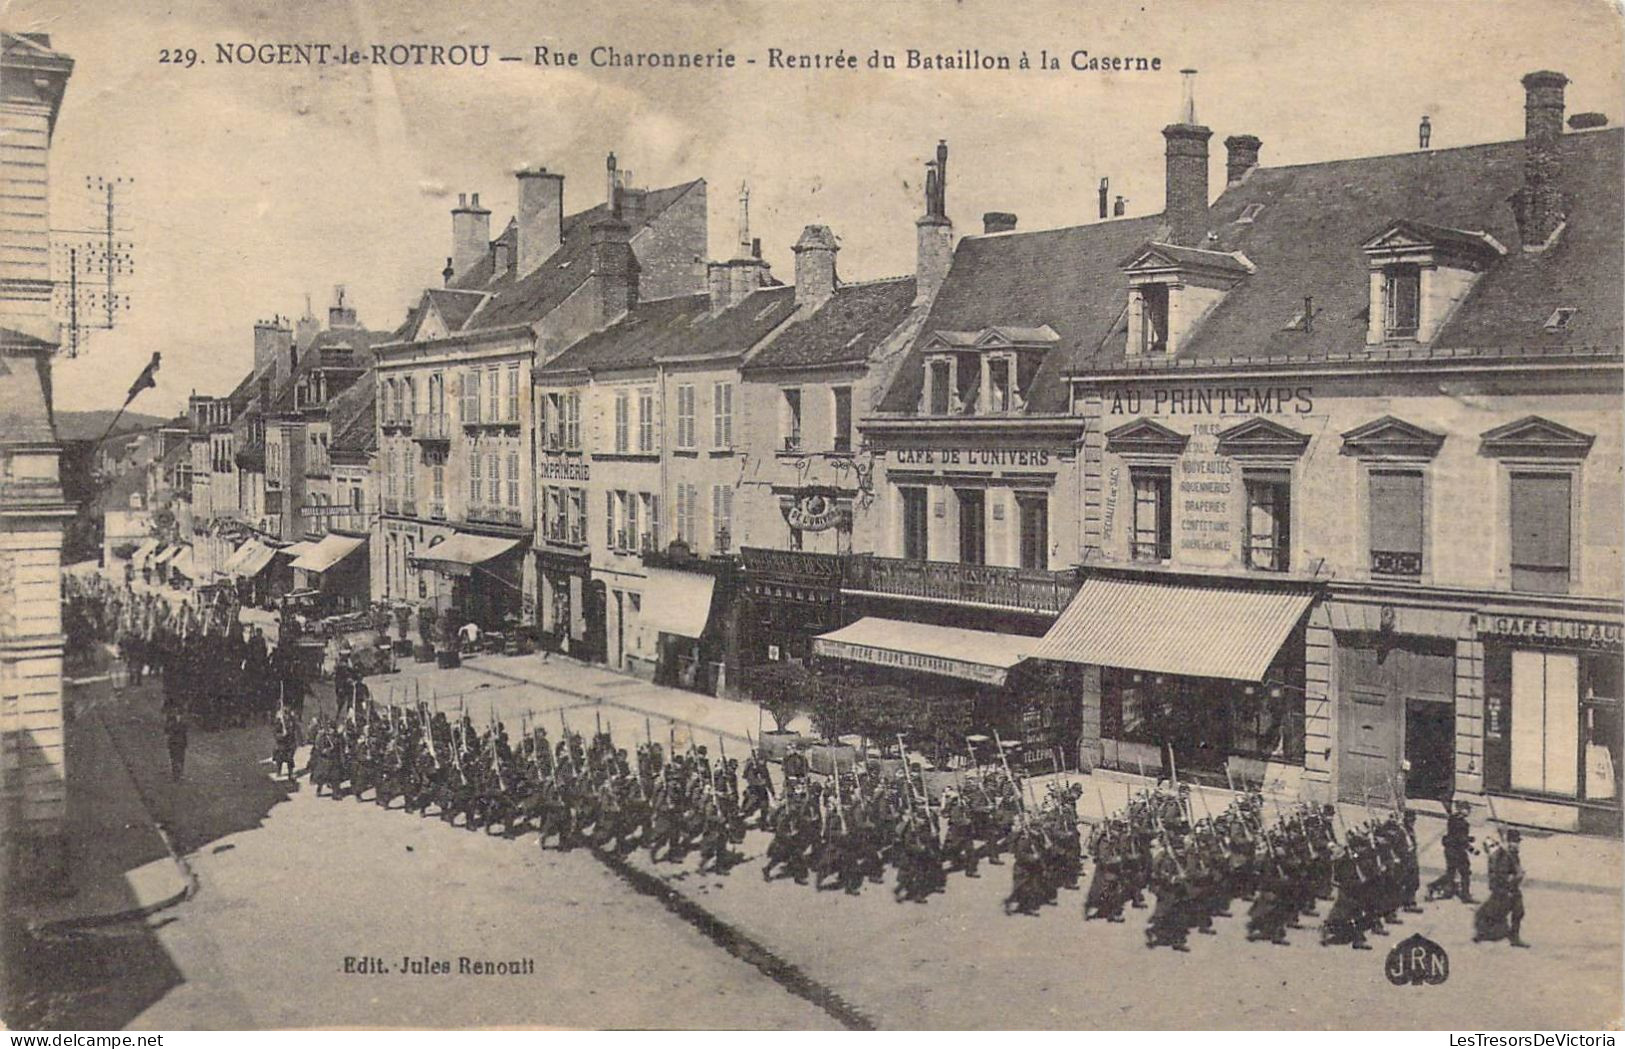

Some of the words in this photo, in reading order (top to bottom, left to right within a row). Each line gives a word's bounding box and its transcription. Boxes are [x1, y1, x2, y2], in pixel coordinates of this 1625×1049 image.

[1110, 389, 1142, 415] AU
[1153, 387, 1313, 415] PRINTEMPS
[941, 449, 960, 464] DE
[968, 449, 1049, 466] L'UNIVERS
[540, 462, 590, 481] IMPRIMERIE
